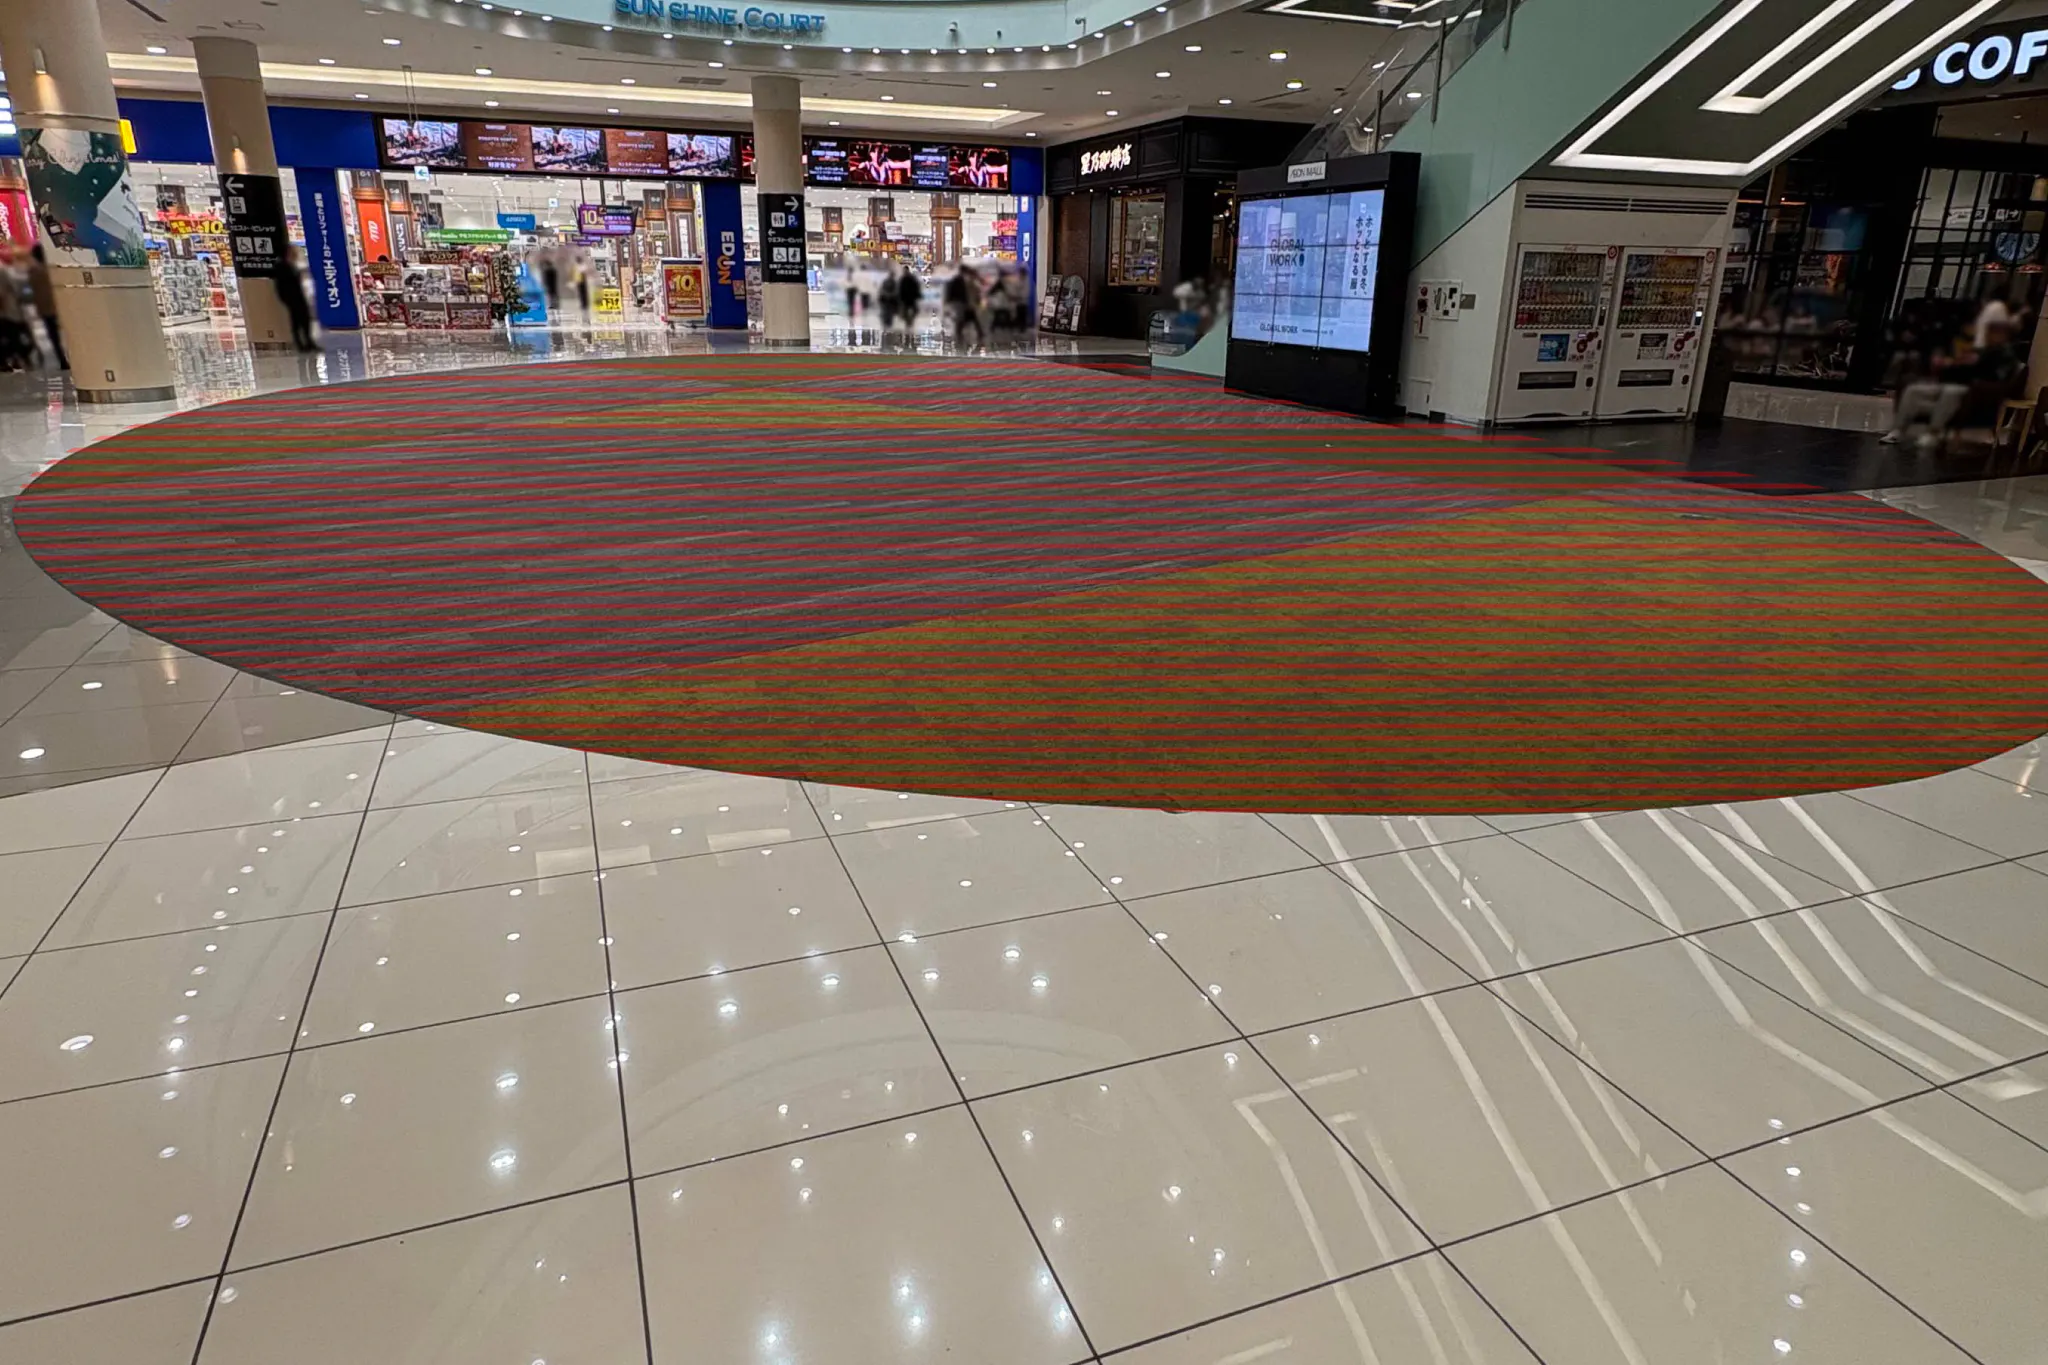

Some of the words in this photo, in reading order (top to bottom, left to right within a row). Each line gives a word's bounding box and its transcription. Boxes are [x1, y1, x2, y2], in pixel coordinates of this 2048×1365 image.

[615, 0, 664, 17] SUN
[669, 2, 737, 26] SHINE
[744, 7, 825, 31] COURT
[1306, 166, 1323, 176] MALL
[368, 220, 380, 243] au
[1270, 239, 1305, 252] GLOBAL
[1269, 254, 1297, 267] WORK
[322, 260, 340, 308] エディオン
